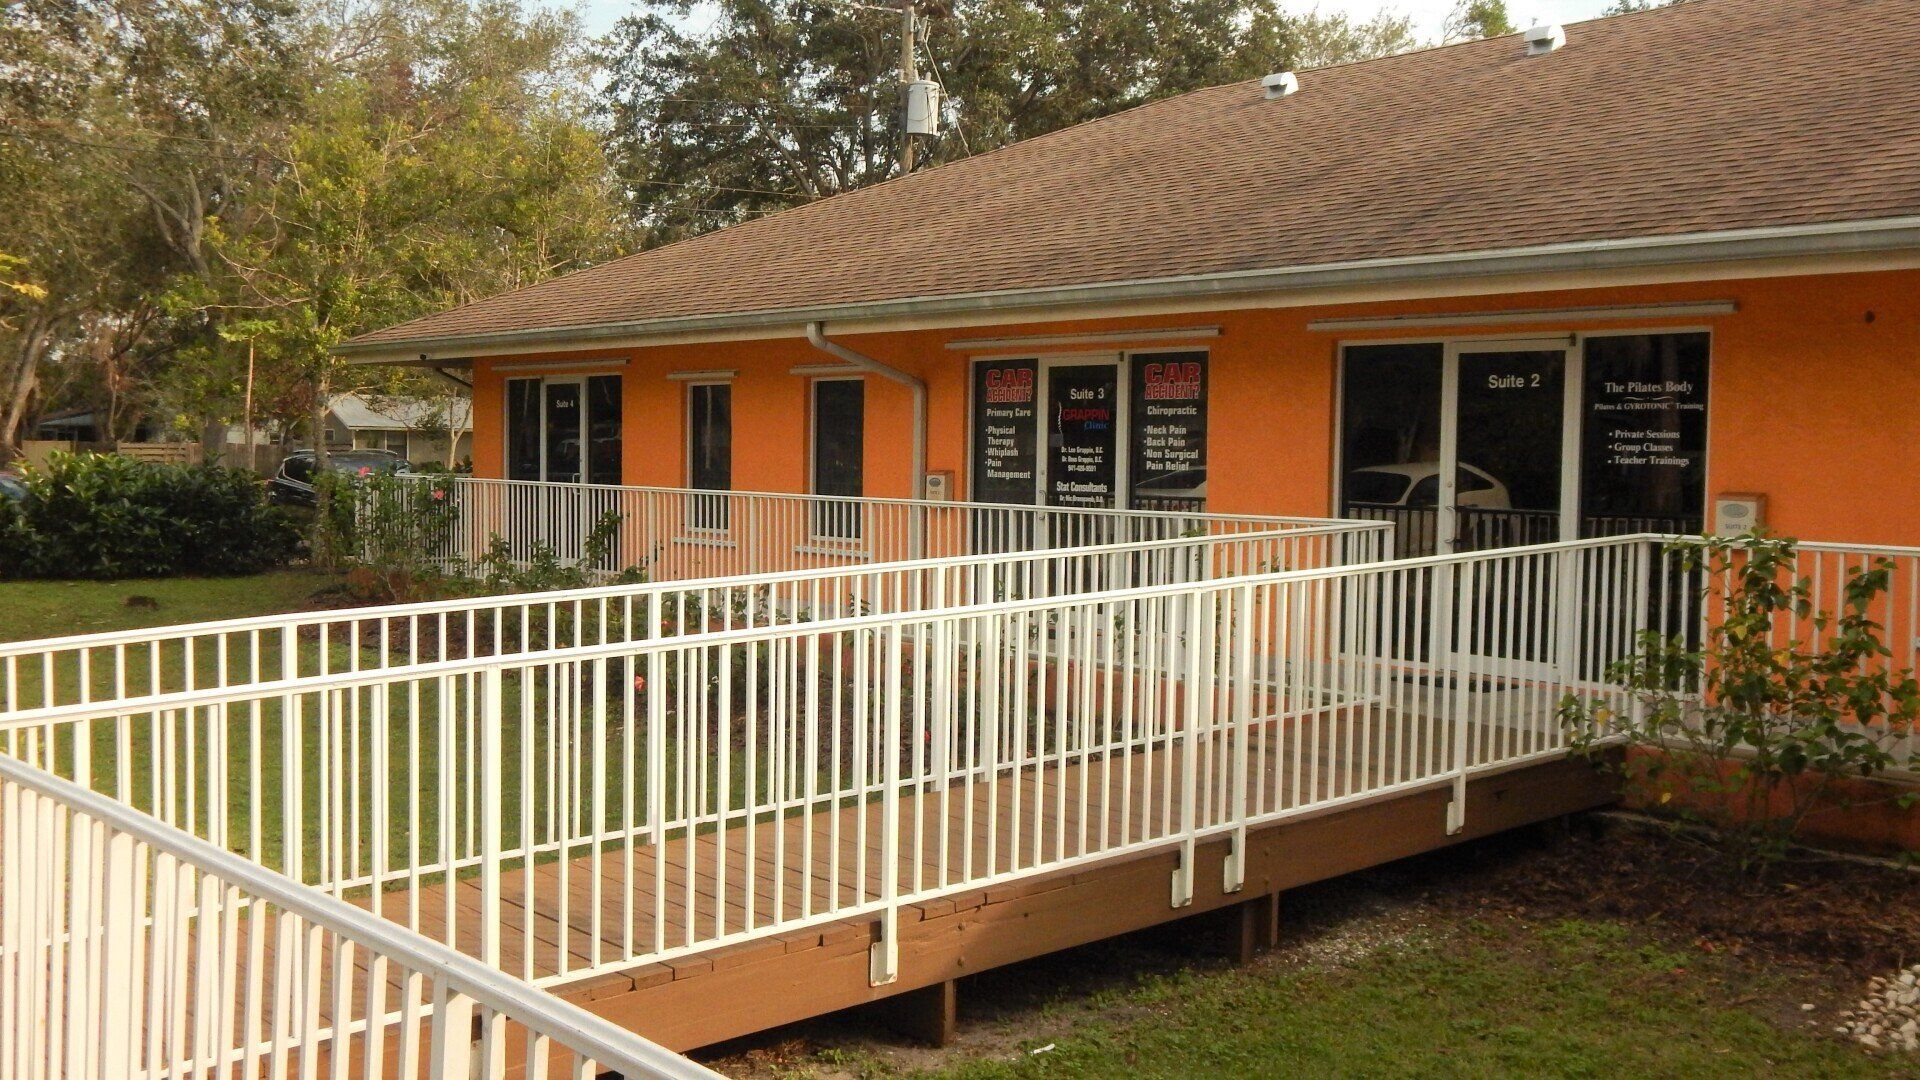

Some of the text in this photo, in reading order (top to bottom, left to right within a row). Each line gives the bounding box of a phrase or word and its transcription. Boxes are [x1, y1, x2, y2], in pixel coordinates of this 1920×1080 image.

[985, 368, 1033, 388] CAR
[1144, 362, 1201, 384] CAR
[1488, 373, 1540, 389] Suite 2
[1144, 383, 1201, 400] ACCIDENT?
[1604, 380, 1694, 395] The Pilates Body
[1070, 387, 1105, 400] Suite 3
[555, 400, 569, 408] Suite
[1676, 403, 1704, 411] Training
[986, 408, 1032, 419] Primary Care
[1062, 408, 1110, 421] GRAPPIN
[1147, 405, 1198, 417] Chiropractic
[987, 425, 1016, 437] Physical
[1146, 424, 1187, 435] Neck Pain
[1614, 430, 1681, 439] Private Sessions
[987, 437, 1015, 447] Therapy
[1146, 437, 1186, 447] Back Pain
[1614, 442, 1674, 453] Group Classes
[987, 447, 1019, 458] Whiplash
[1146, 449, 1199, 460] Non Surgical
[987, 459, 1002, 467] Pain
[1146, 461, 1190, 471] Pain Relief
[1613, 456, 1690, 467] Teacher Trainings
[987, 469, 1031, 480] Management
[1056, 481, 1108, 493] Stat Consultants
